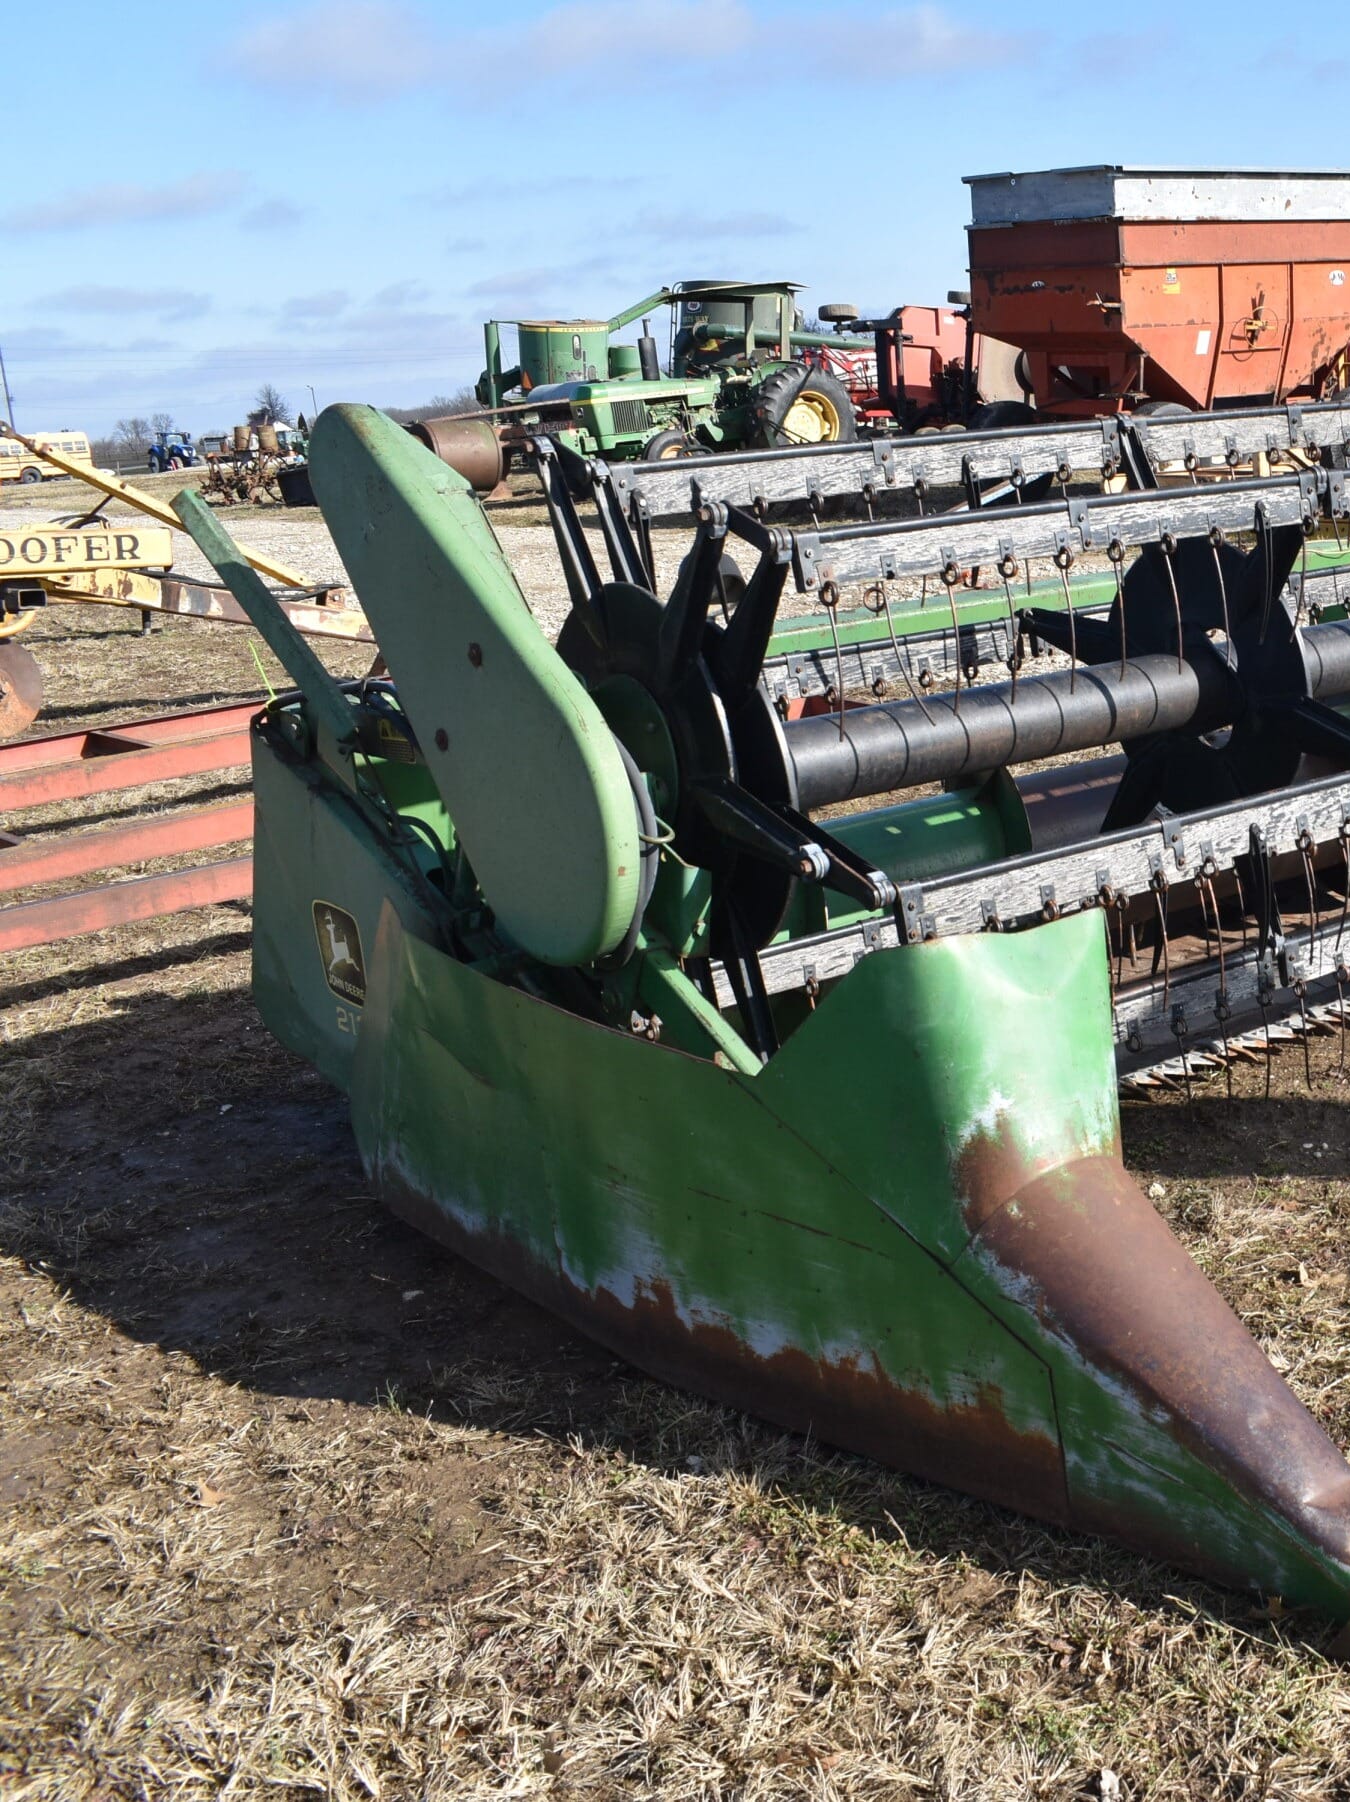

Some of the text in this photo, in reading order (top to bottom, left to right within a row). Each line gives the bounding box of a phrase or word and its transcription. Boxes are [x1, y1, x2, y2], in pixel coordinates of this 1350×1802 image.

[329, 974, 365, 998] JOHN DEERE
[336, 1006, 361, 1036] 21
